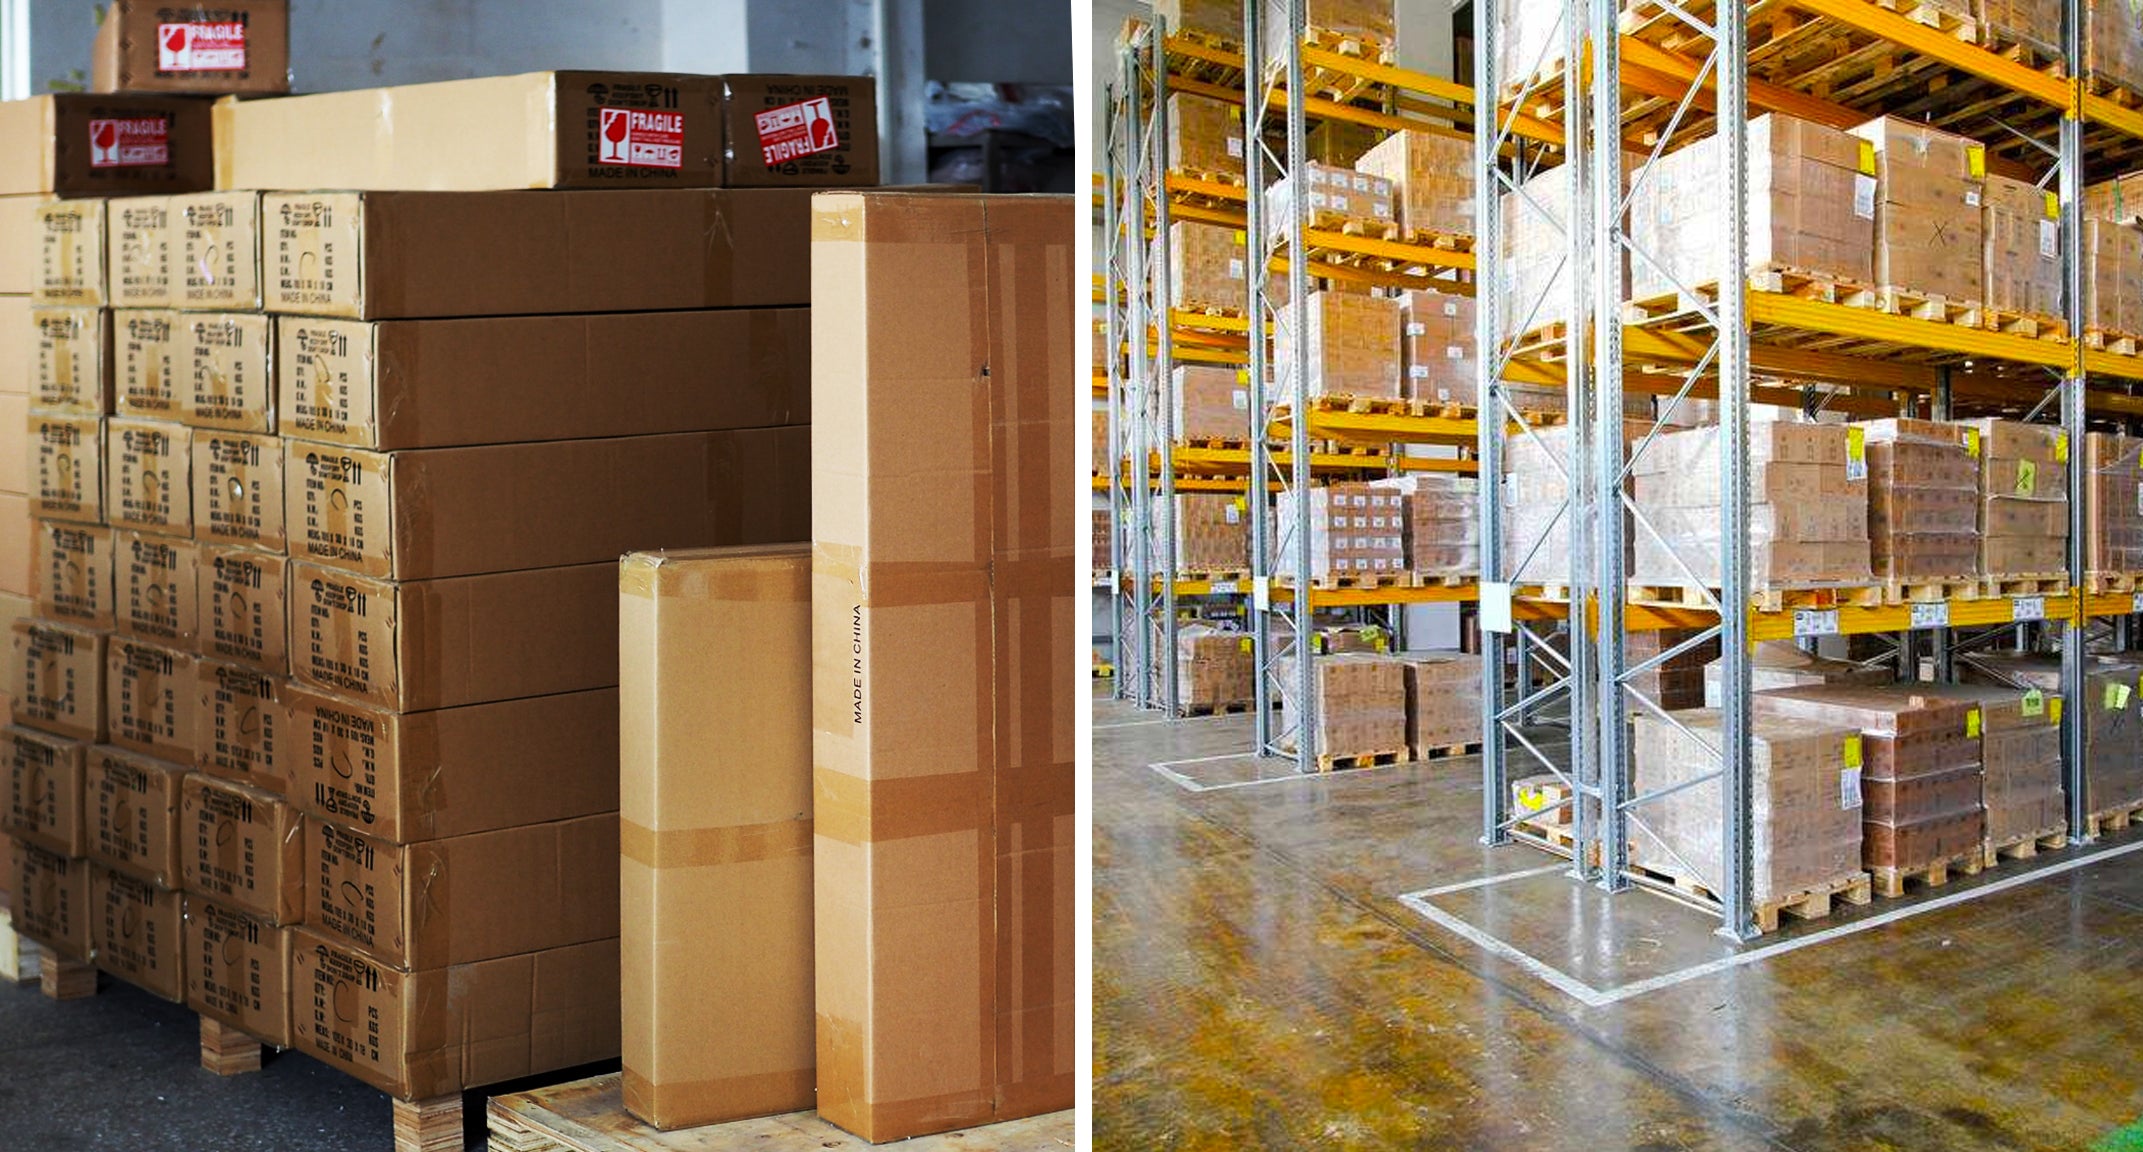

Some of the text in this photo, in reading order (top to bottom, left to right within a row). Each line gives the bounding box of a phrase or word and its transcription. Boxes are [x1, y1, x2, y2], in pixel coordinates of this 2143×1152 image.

[190, 24, 243, 40] FRAGILE
[119, 118, 167, 135] FRAGILE
[631, 112, 683, 133] FRAGILE
[764, 136, 811, 164] FRAGILE
[588, 167, 678, 179] MADE IN CHINA
[296, 417, 347, 434] MADE IN CHINA
[308, 542, 363, 563] MADE IN CHINA
[853, 604, 862, 724] MADE IN CHINA
[312, 668, 368, 694] MADE IN CHINA
[315, 705, 340, 723] CHINA
[341, 713, 350, 725] IN
[351, 715, 374, 732] MADE
